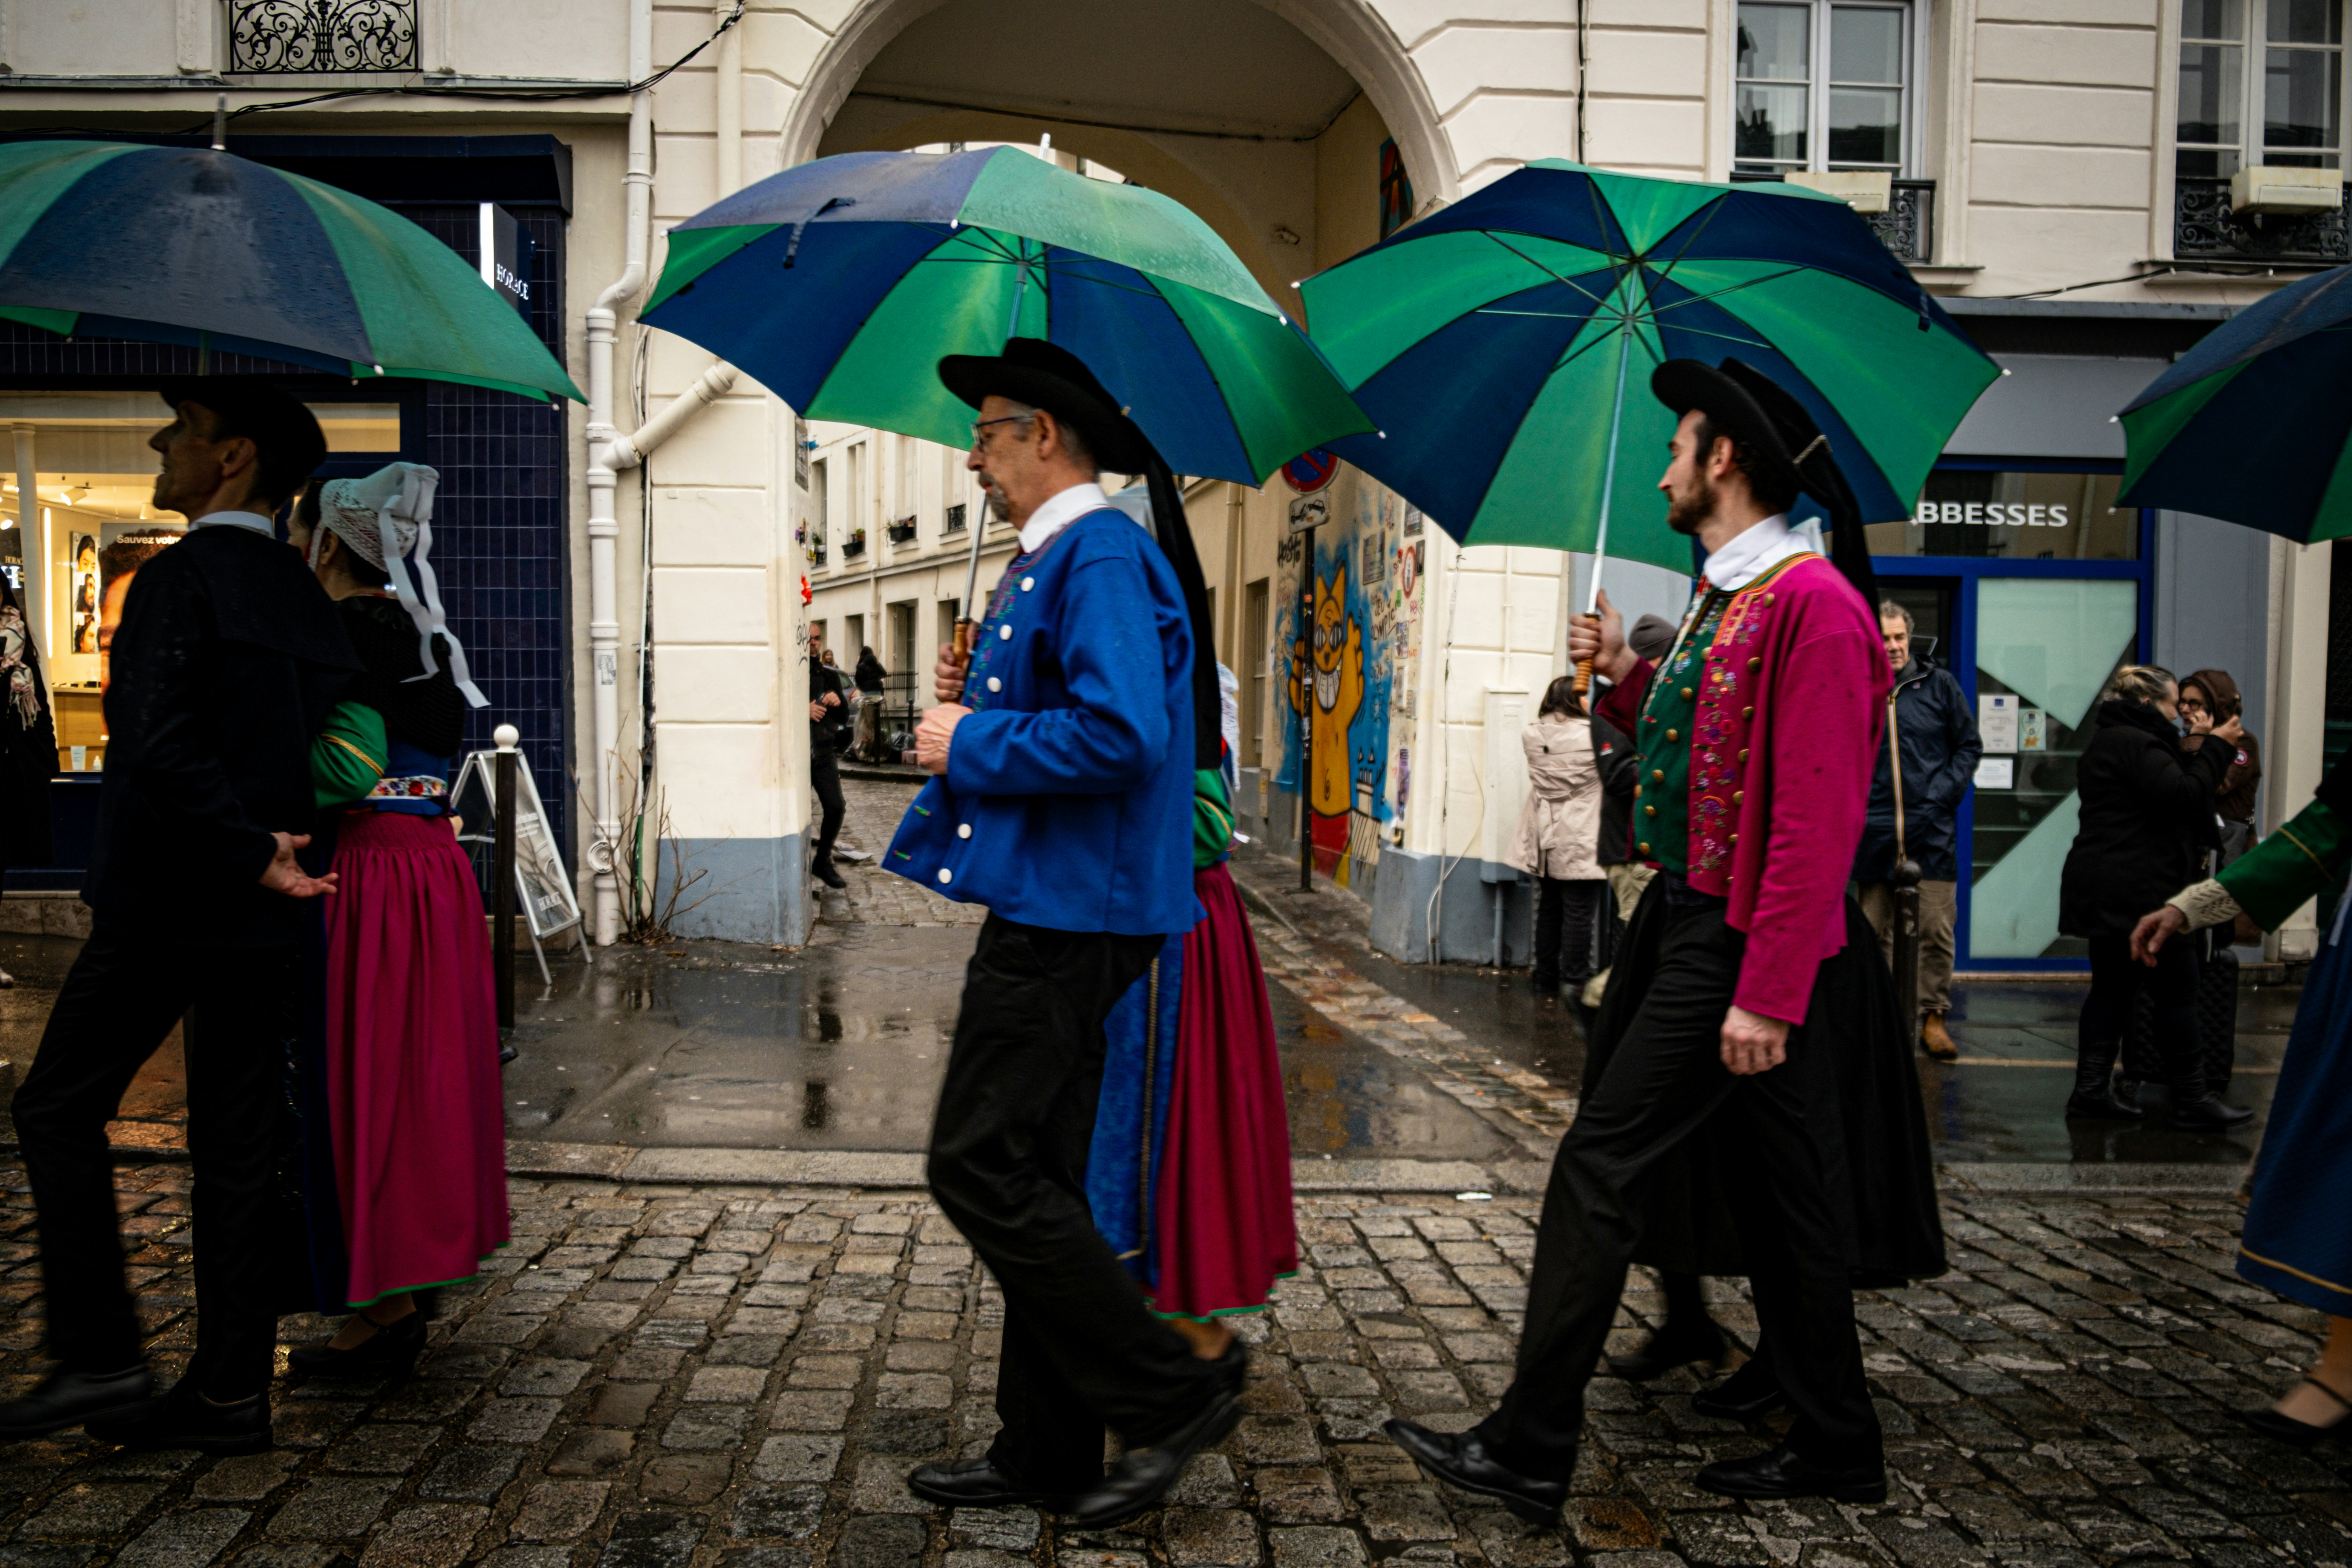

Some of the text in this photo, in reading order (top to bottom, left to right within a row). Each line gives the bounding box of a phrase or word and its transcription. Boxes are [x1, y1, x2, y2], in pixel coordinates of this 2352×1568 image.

[496, 263, 529, 300] HORACE
[1918, 501, 2068, 527] BBESSES
[116, 535, 155, 544] Sauvez
